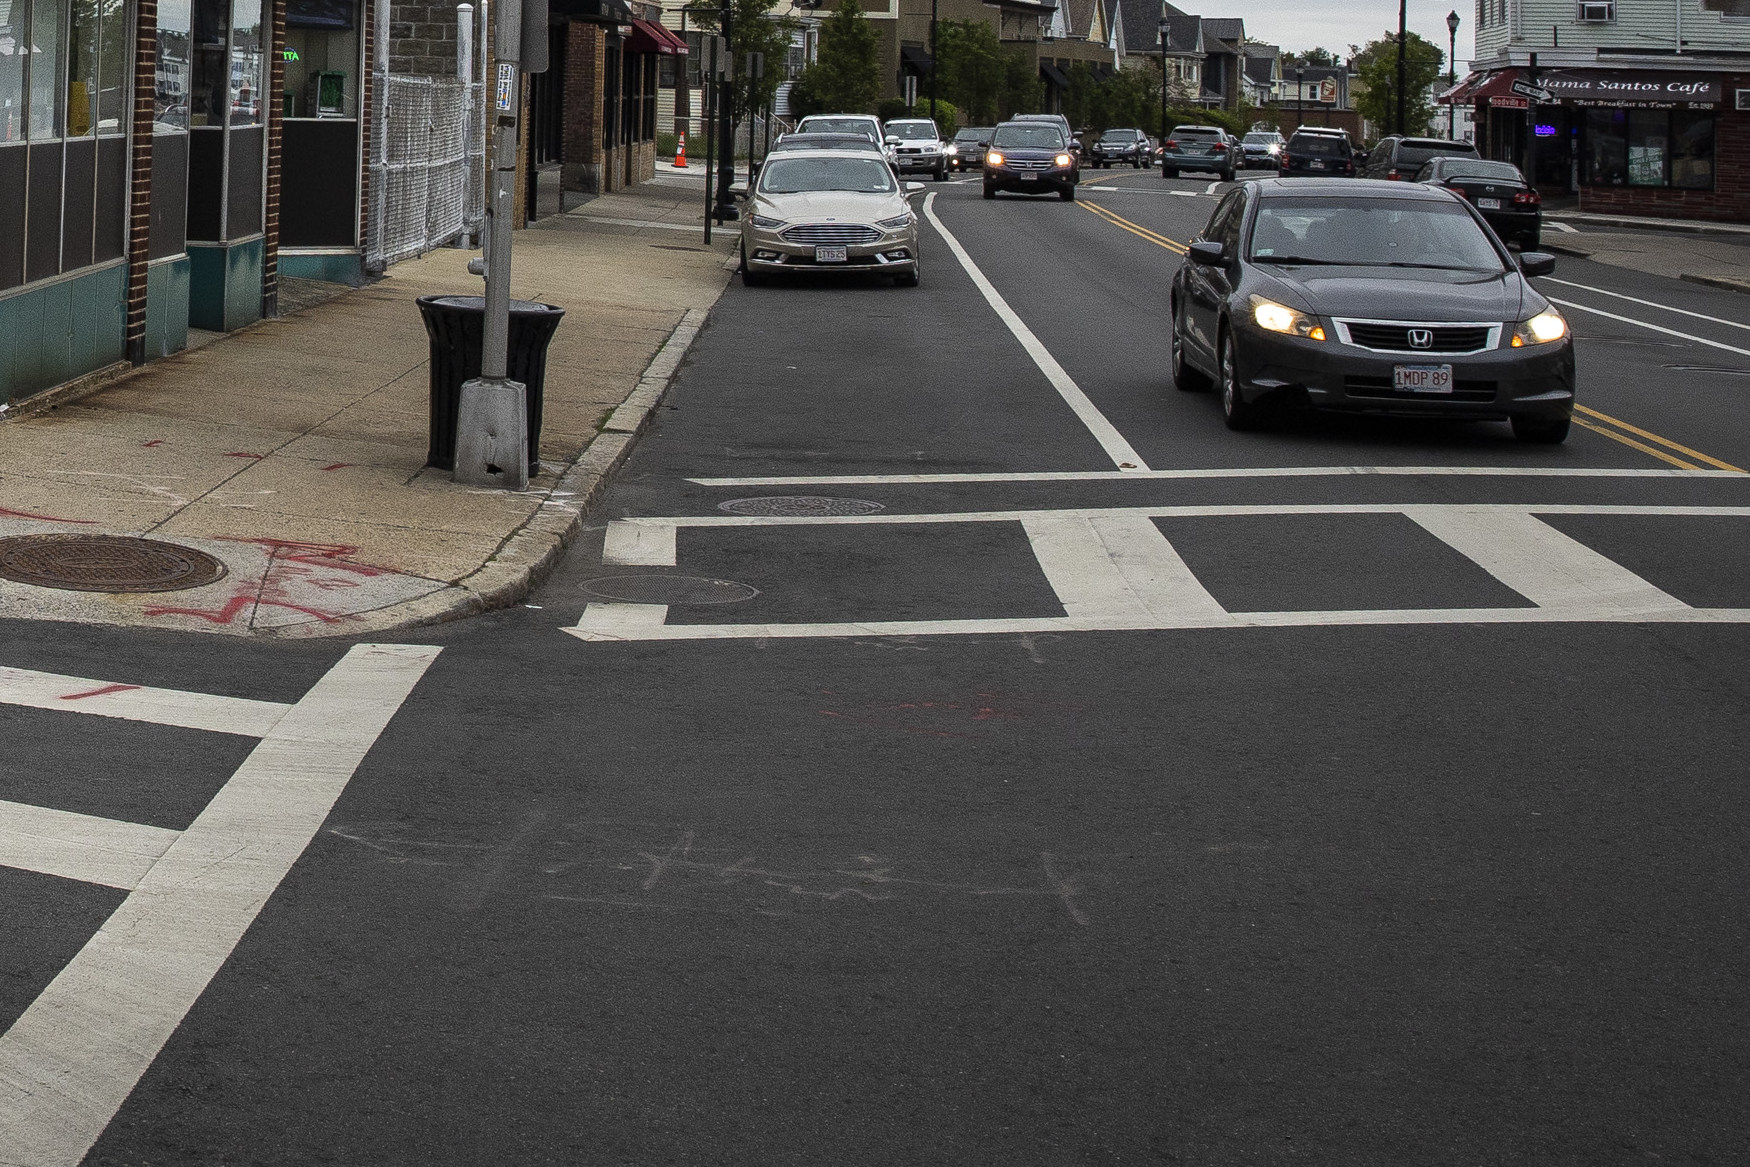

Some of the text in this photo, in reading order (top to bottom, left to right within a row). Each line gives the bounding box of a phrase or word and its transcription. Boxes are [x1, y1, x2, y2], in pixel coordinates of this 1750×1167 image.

[1536, 78, 1710, 95] Mama Santos Café
[1597, 100, 1636, 108] Breakfast
[1395, 371, 1449, 386] 1MDP 89
